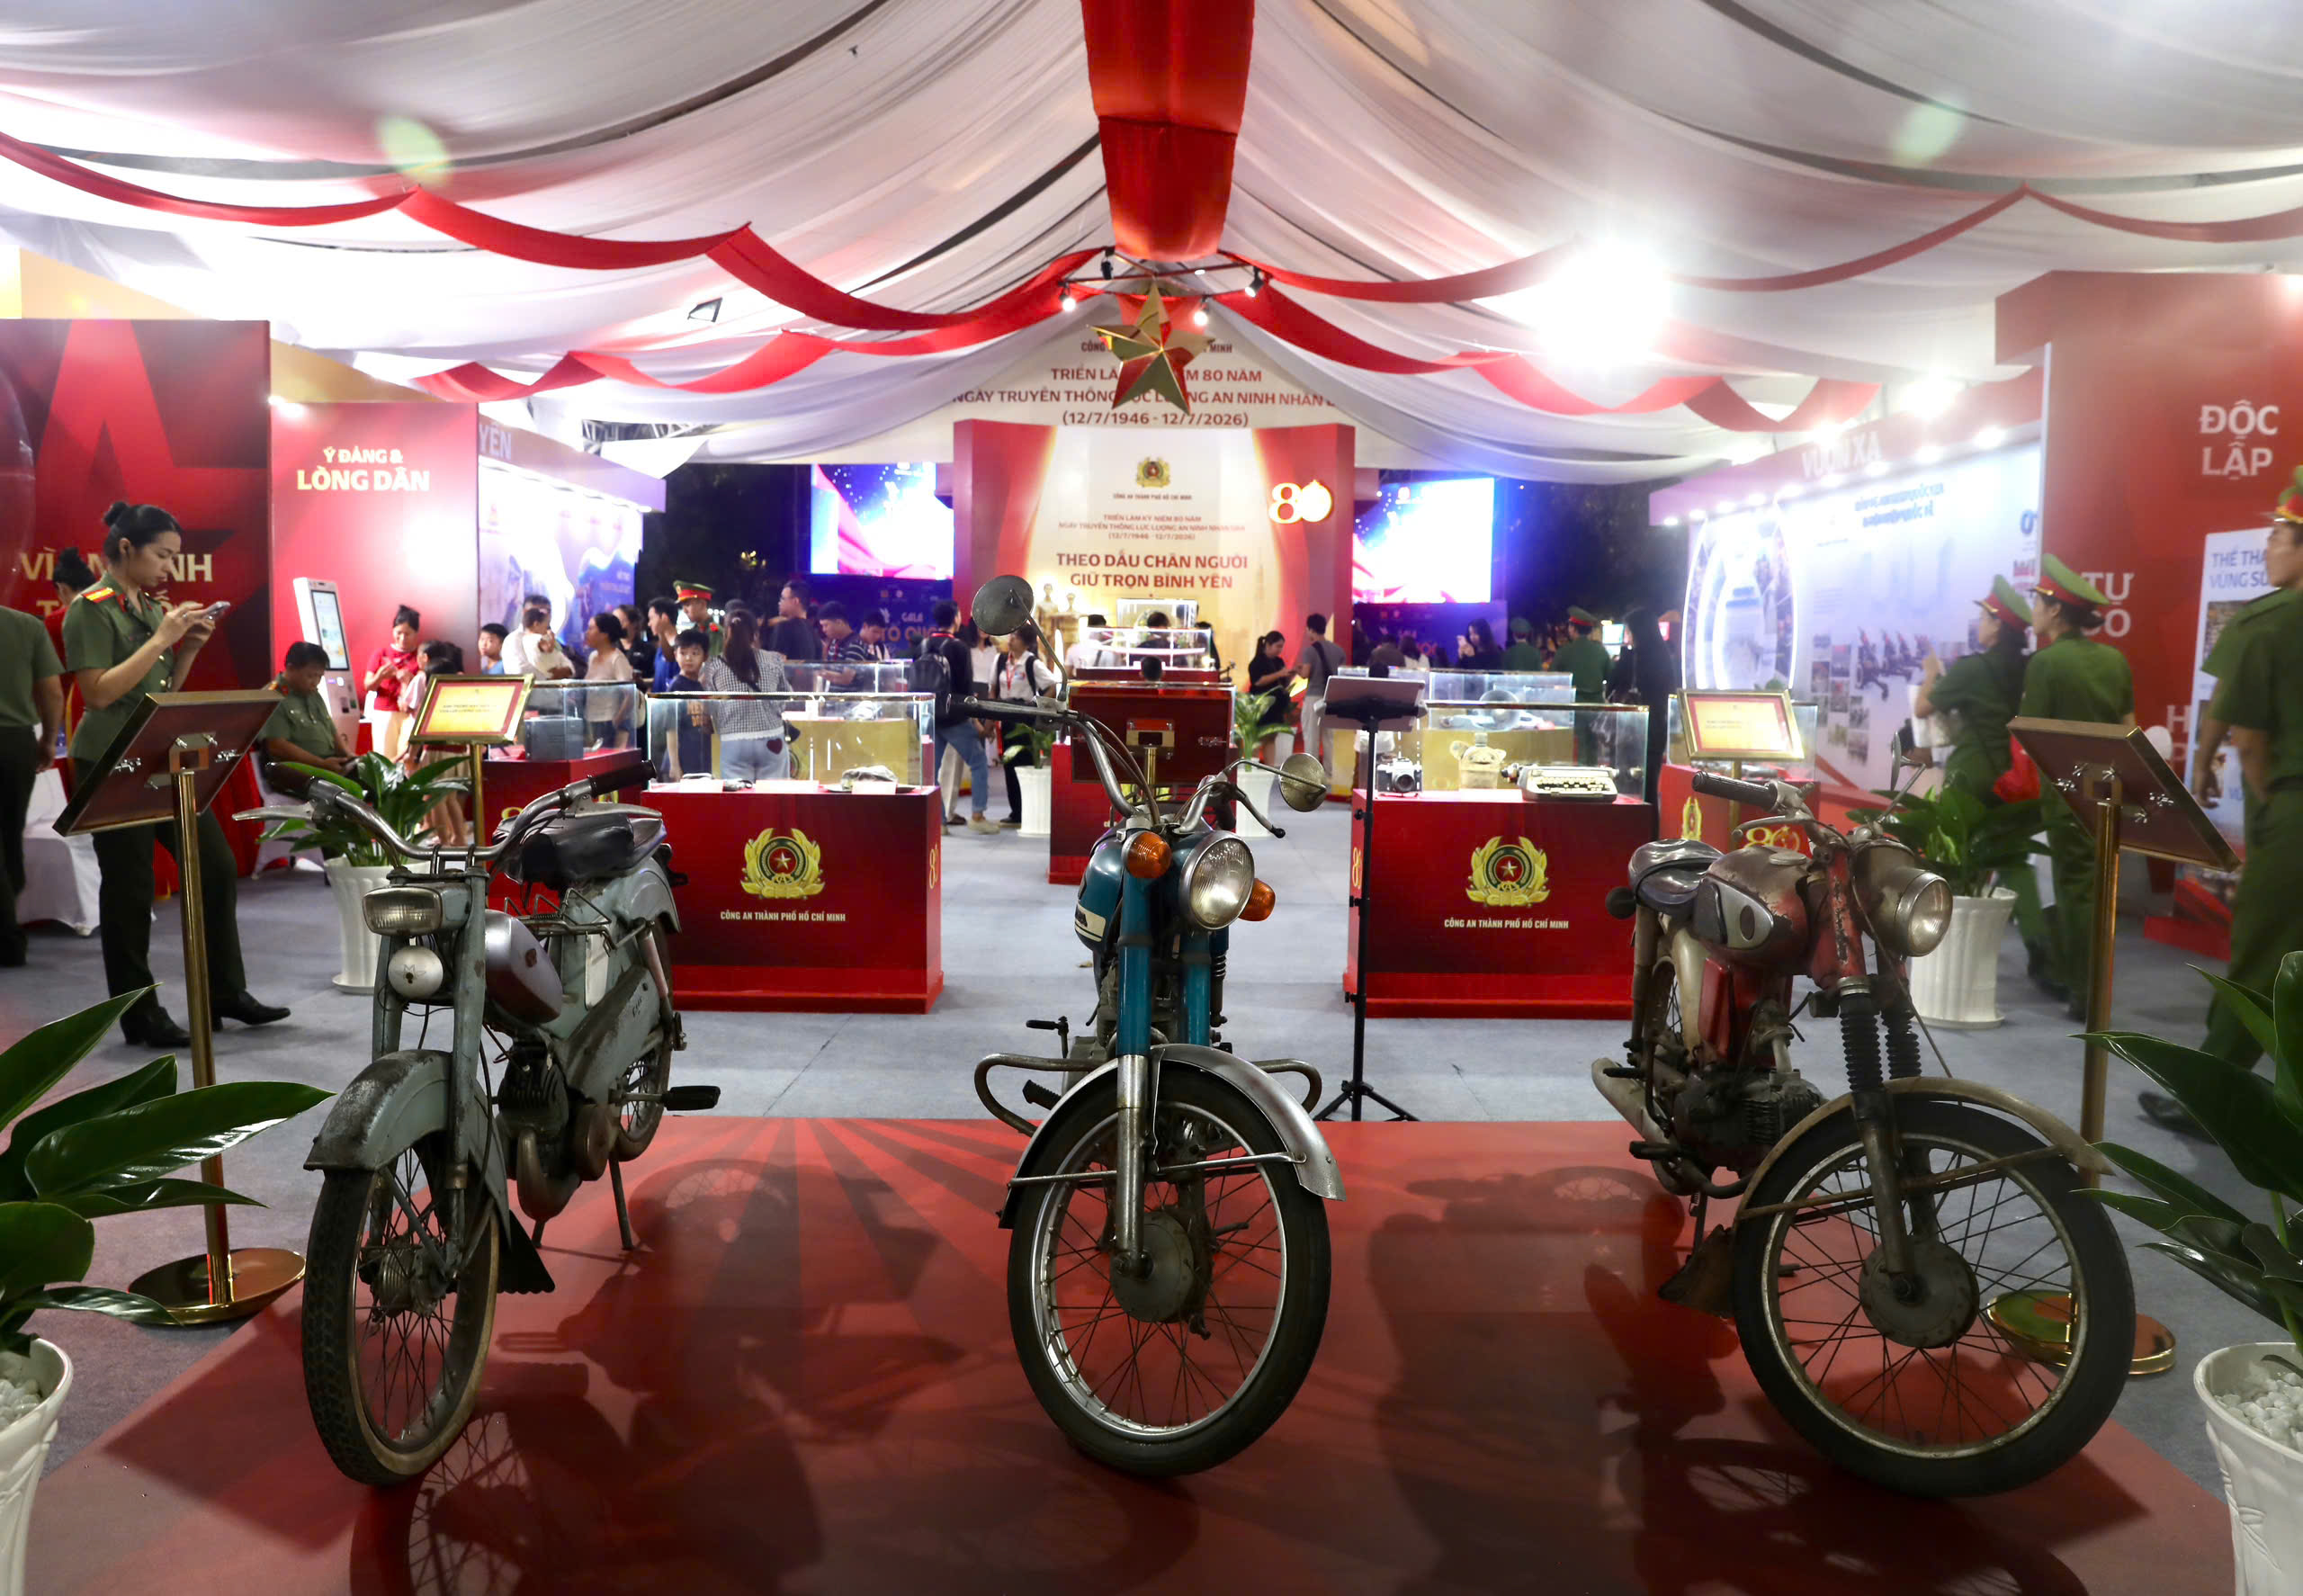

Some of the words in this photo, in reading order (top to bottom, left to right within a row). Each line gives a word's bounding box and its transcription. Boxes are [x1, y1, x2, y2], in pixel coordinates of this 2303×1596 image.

[1203, 369, 1223, 381] 80
[1212, 391, 1233, 404] AN
[1237, 391, 1276, 404] NINH
[1062, 410, 1150, 426] (12/7/1946
[1163, 412, 1249, 427] 12/7/2026)
[2199, 399, 2280, 439] ĐỘC
[323, 446, 336, 463] Ý
[390, 449, 404, 463] &
[2201, 441, 2273, 480] LẬP
[297, 465, 369, 490] LÒNG
[373, 466, 430, 491] DÂN
[1057, 553, 1100, 567] THEO
[1105, 550, 1140, 568] DẤU
[1143, 552, 1190, 569] CHÂN
[1103, 573, 1150, 588] TRỌN
[1153, 574, 1195, 587] BÌNH
[1199, 573, 1232, 588] YÊN
[720, 910, 740, 920] CÔNG
[742, 911, 753, 920] AN
[755, 910, 779, 920] THÀNH
[781, 910, 797, 921] PHỐ
[799, 910, 810, 921] HỒ
[811, 910, 825, 921] CHÍ
[826, 913, 846, 922] MINH
[1444, 917, 1465, 928] CÔNG
[1466, 919, 1477, 928] AN
[1478, 917, 1503, 928] THÀNH
[1504, 917, 1520, 928] PHỐ
[1522, 917, 1533, 928] HỒ
[1535, 918, 1548, 928] CHÍ
[1549, 920, 1569, 929] MINH
